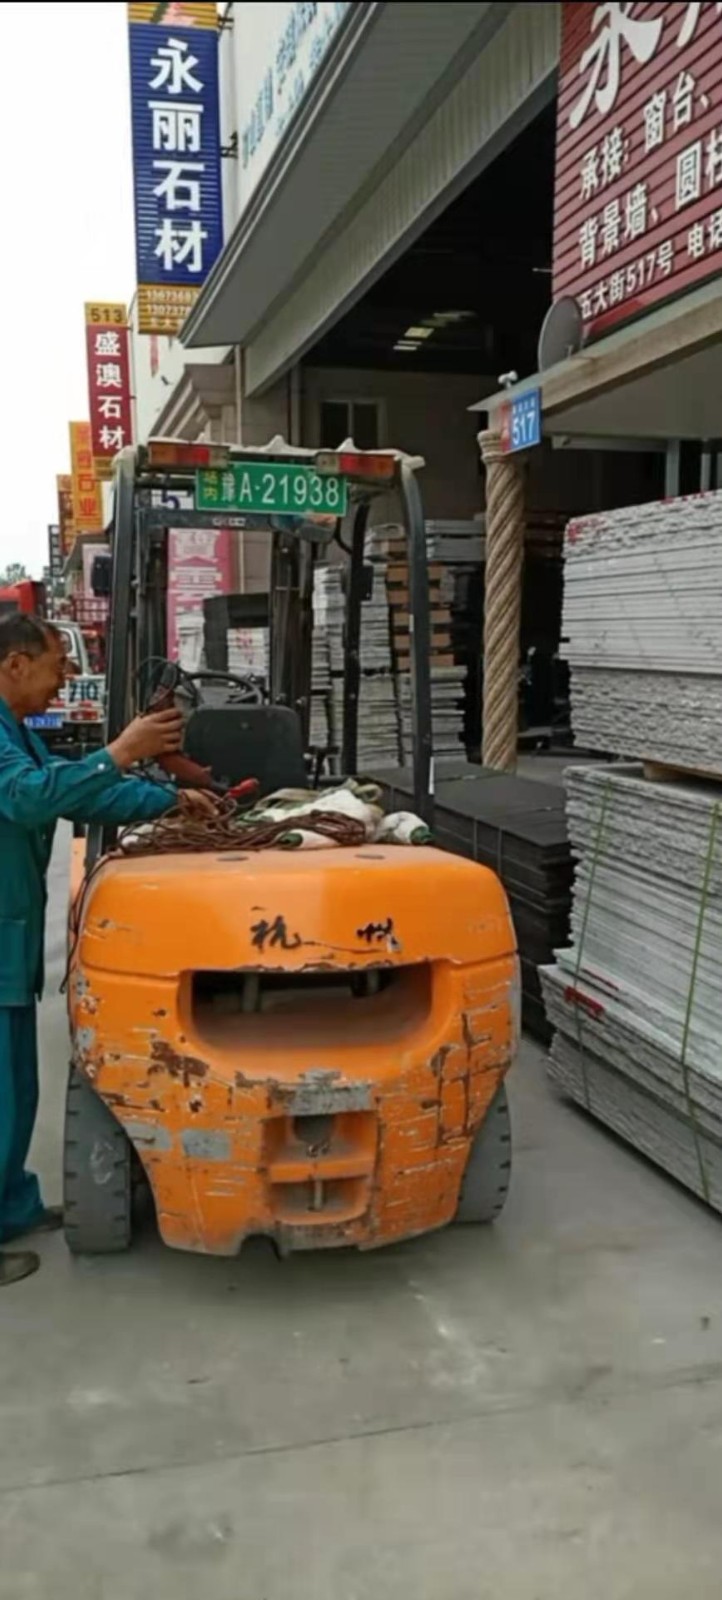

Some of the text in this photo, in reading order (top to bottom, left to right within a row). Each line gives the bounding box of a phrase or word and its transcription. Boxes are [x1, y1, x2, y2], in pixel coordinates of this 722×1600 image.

[147, 38, 208, 273] 永丽石材
[90, 308, 124, 323] 513
[94, 331, 126, 449] 盛澳石材
[512, 410, 535, 446] 517
